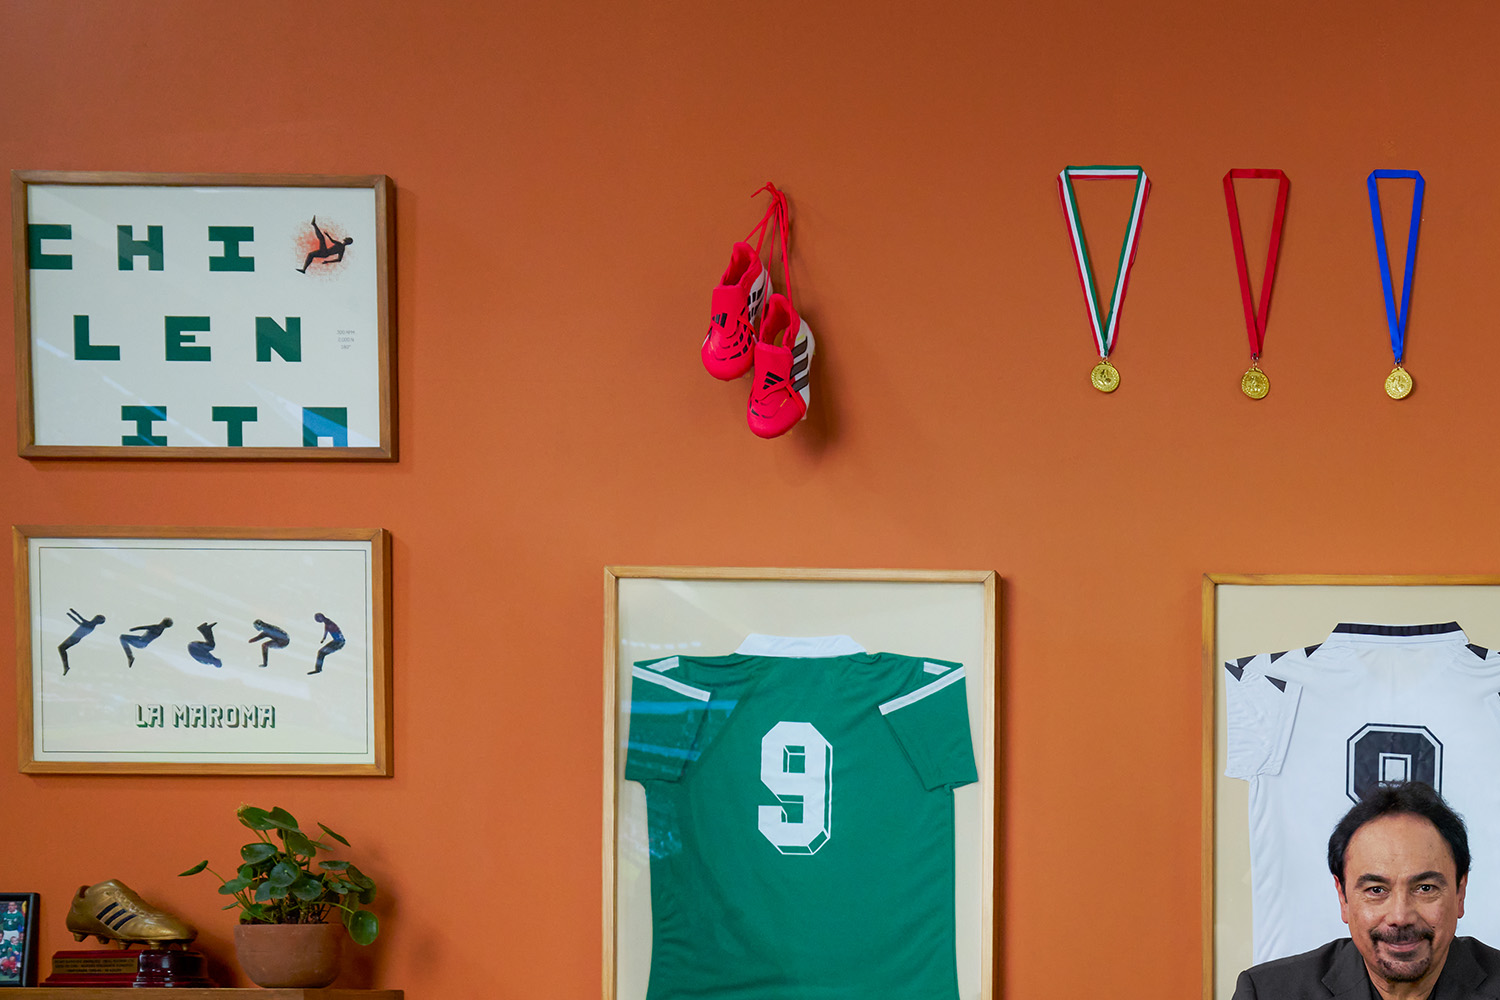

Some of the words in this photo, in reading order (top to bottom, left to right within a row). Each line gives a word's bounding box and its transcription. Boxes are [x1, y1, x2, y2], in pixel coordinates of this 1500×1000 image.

[135, 704, 164, 728] LA
[172, 704, 276, 729] MAROMA
[757, 720, 833, 856] 9
